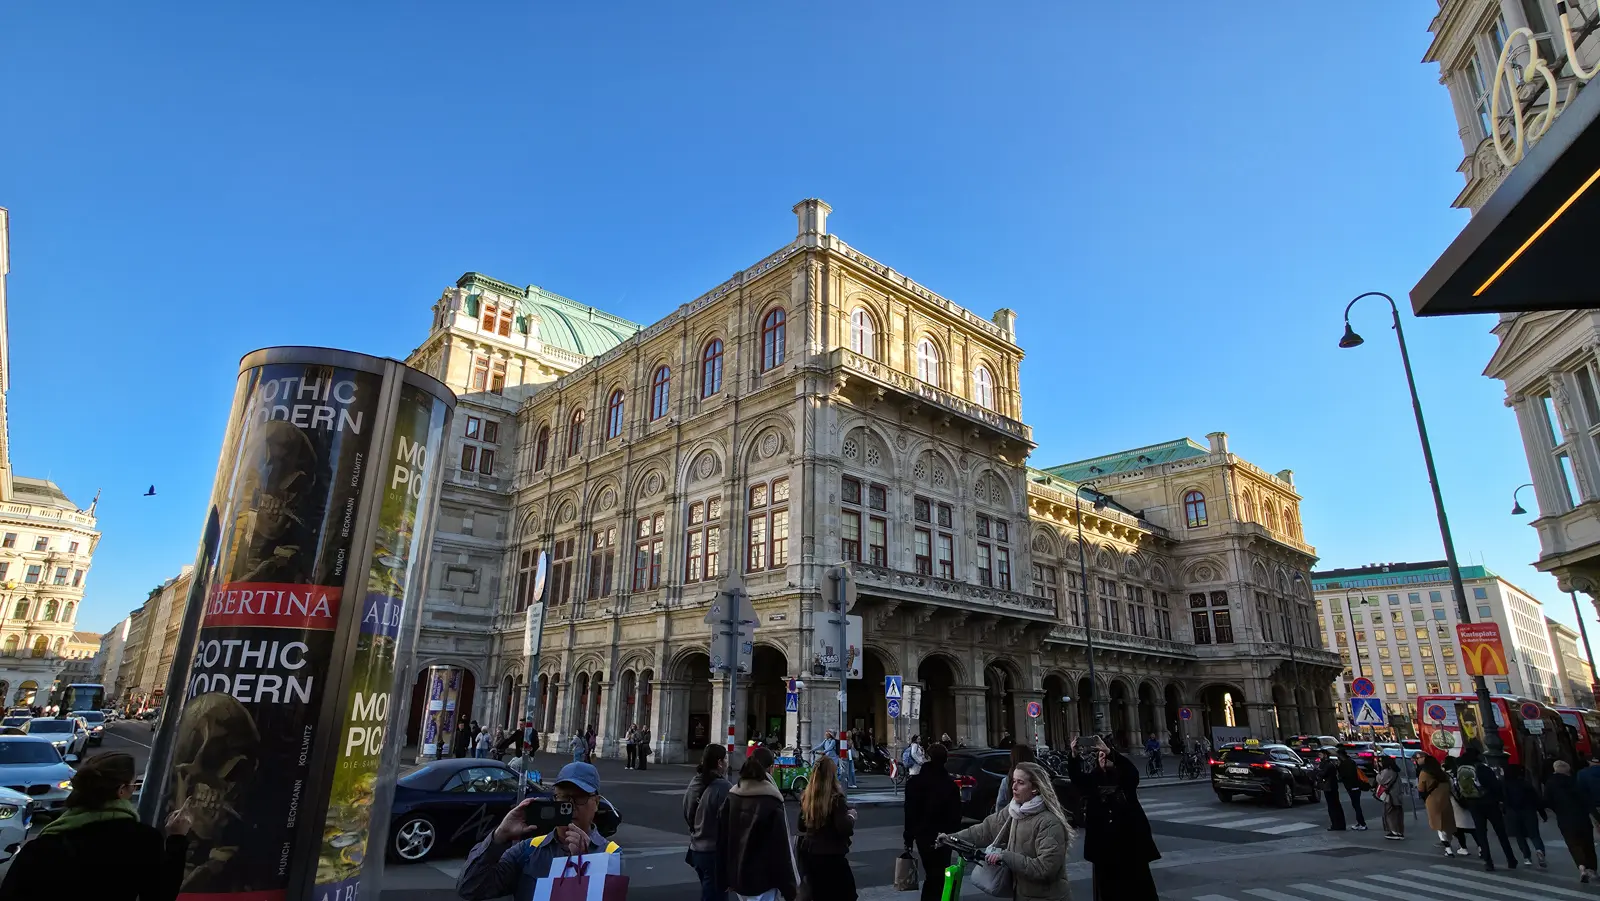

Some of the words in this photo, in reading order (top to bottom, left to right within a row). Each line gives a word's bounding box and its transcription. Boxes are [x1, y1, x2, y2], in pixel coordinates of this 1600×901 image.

[254, 404, 364, 435] ODERN
[259, 376, 359, 404] OTHIC
[335, 548, 346, 576] MUNCH
[342, 497, 355, 538] BECKMANN
[351, 452, 363, 487] KOLLWITZ
[278, 842, 291, 876] MUNCH
[287, 779, 303, 829] BECKMANN
[298, 724, 313, 767] KOLLWITZ
